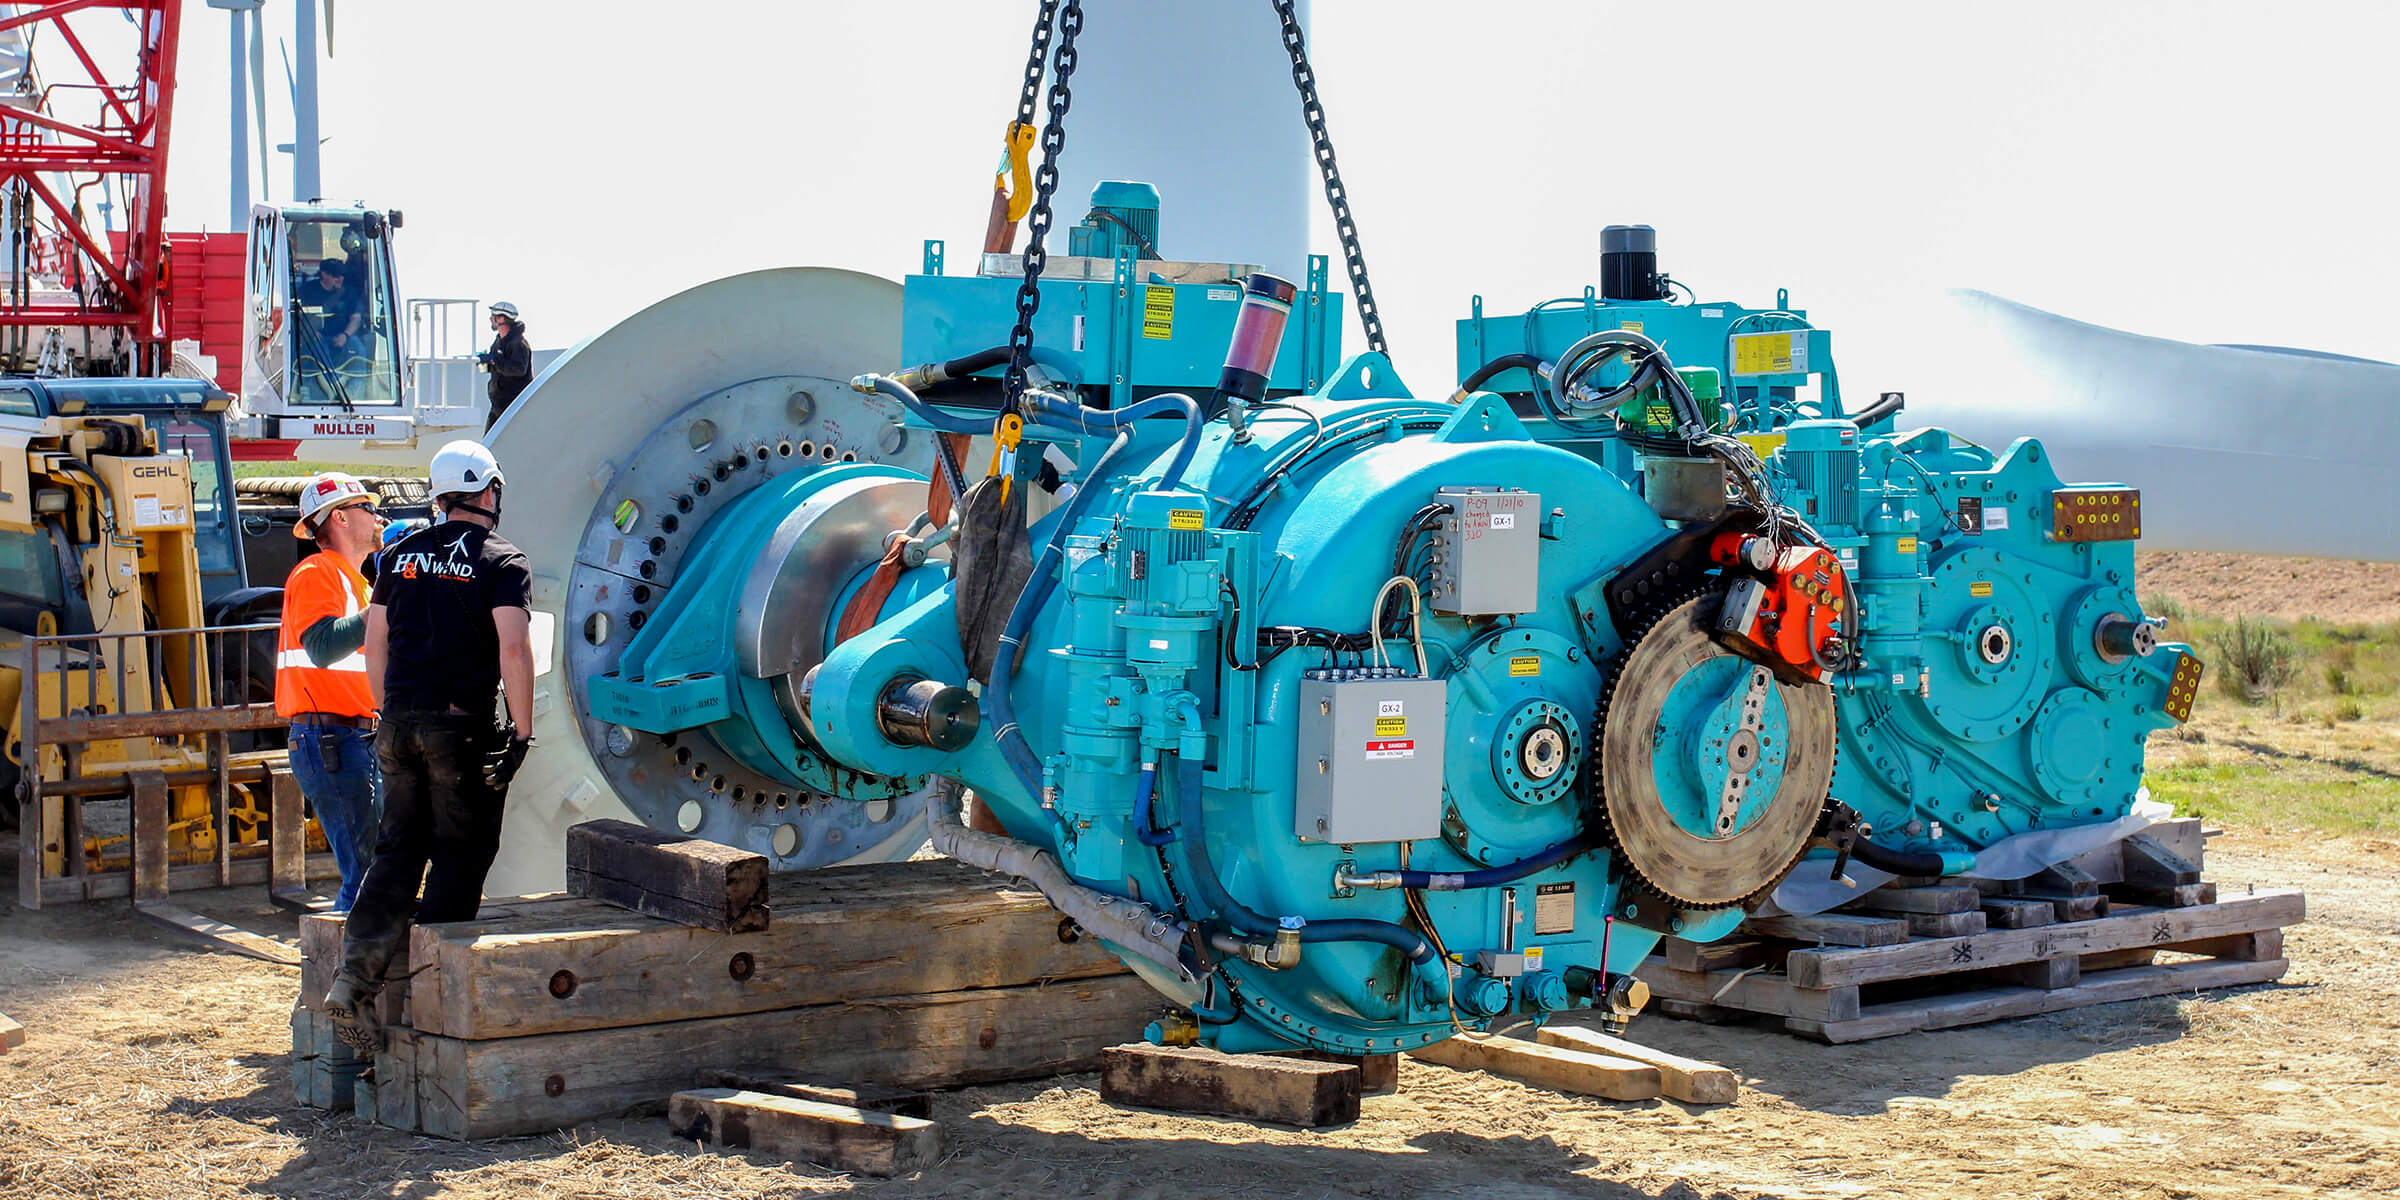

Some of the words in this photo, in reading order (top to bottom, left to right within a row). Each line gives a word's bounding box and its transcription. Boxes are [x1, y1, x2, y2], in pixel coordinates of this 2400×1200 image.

[313, 423, 375, 435] MULLEN
[132, 466, 179, 478] GEHL
[1493, 517, 1511, 525] GX-1
[391, 552, 436, 579] H&N
[1381, 704, 1401, 713] GX-2
